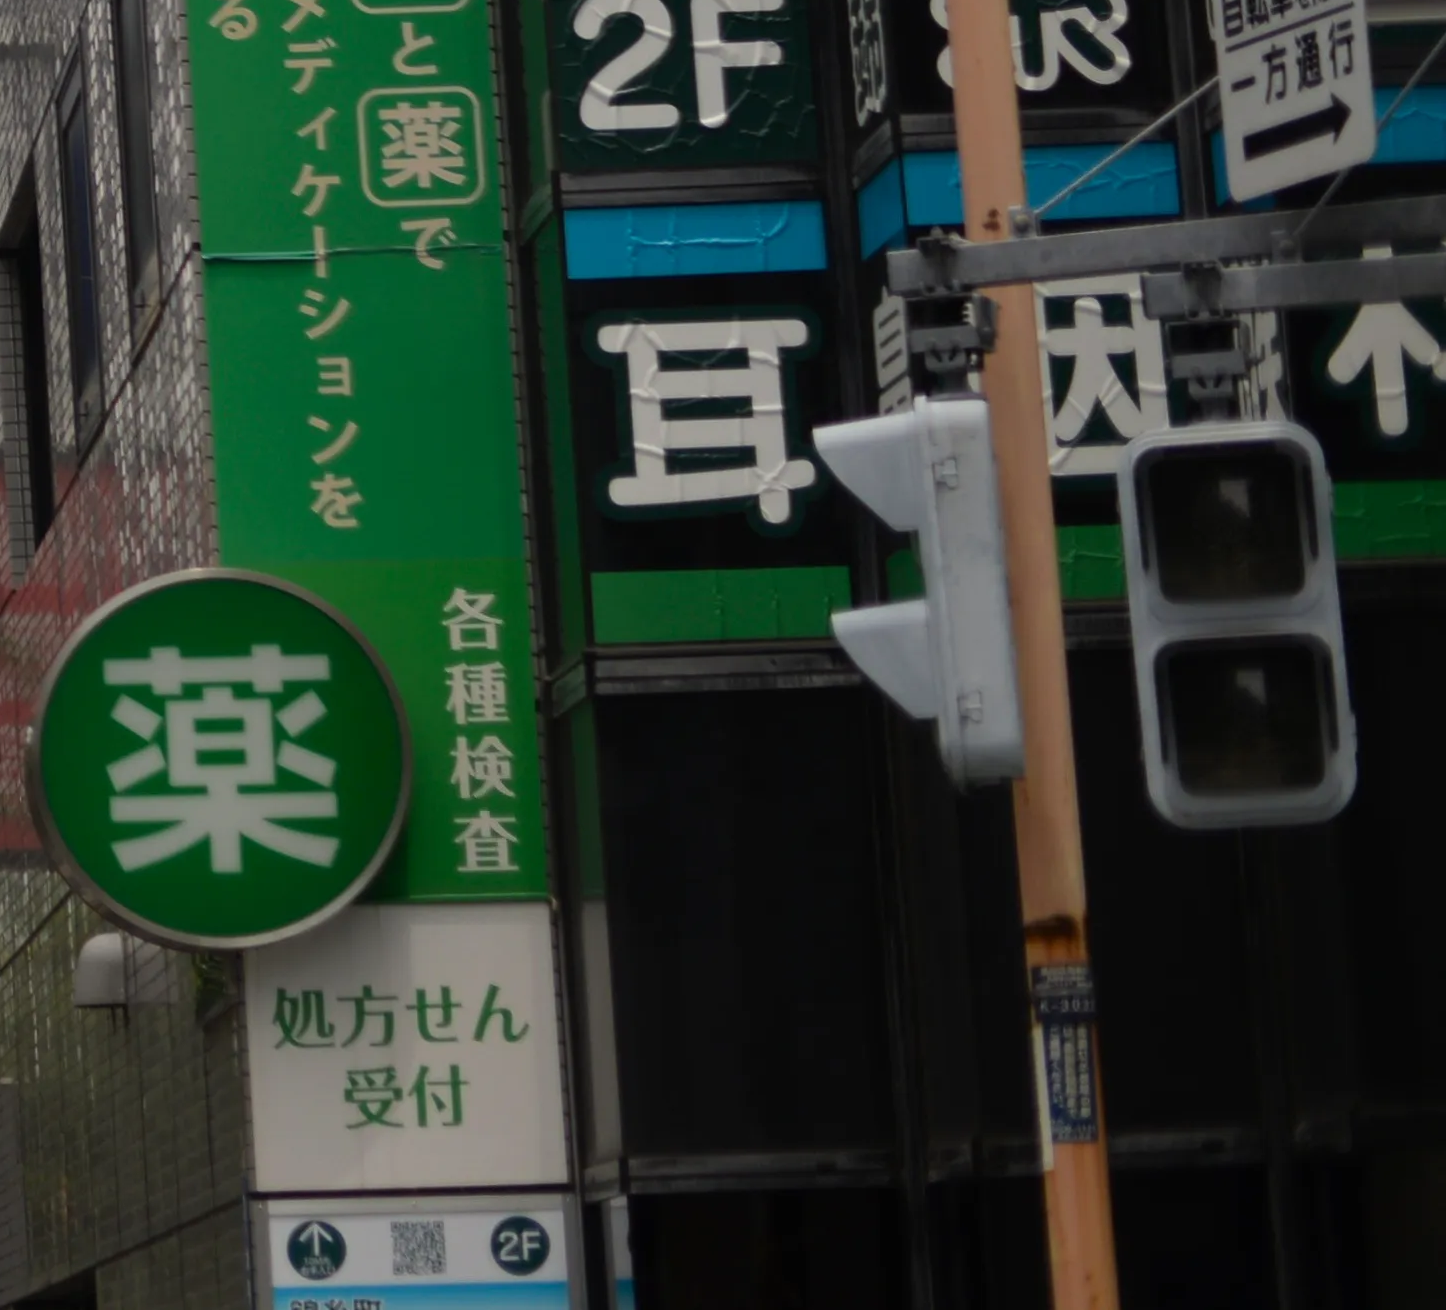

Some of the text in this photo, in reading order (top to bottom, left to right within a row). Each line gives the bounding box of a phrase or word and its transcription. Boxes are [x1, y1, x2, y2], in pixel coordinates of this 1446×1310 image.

[1230, 18, 1355, 105] 一方通行
[101, 644, 341, 874] 薬
[441, 586, 521, 874] 各種検査
[271, 984, 530, 1051] 処方せん
[342, 1064, 469, 1130] 受付
[498, 1230, 541, 1263] 2F
